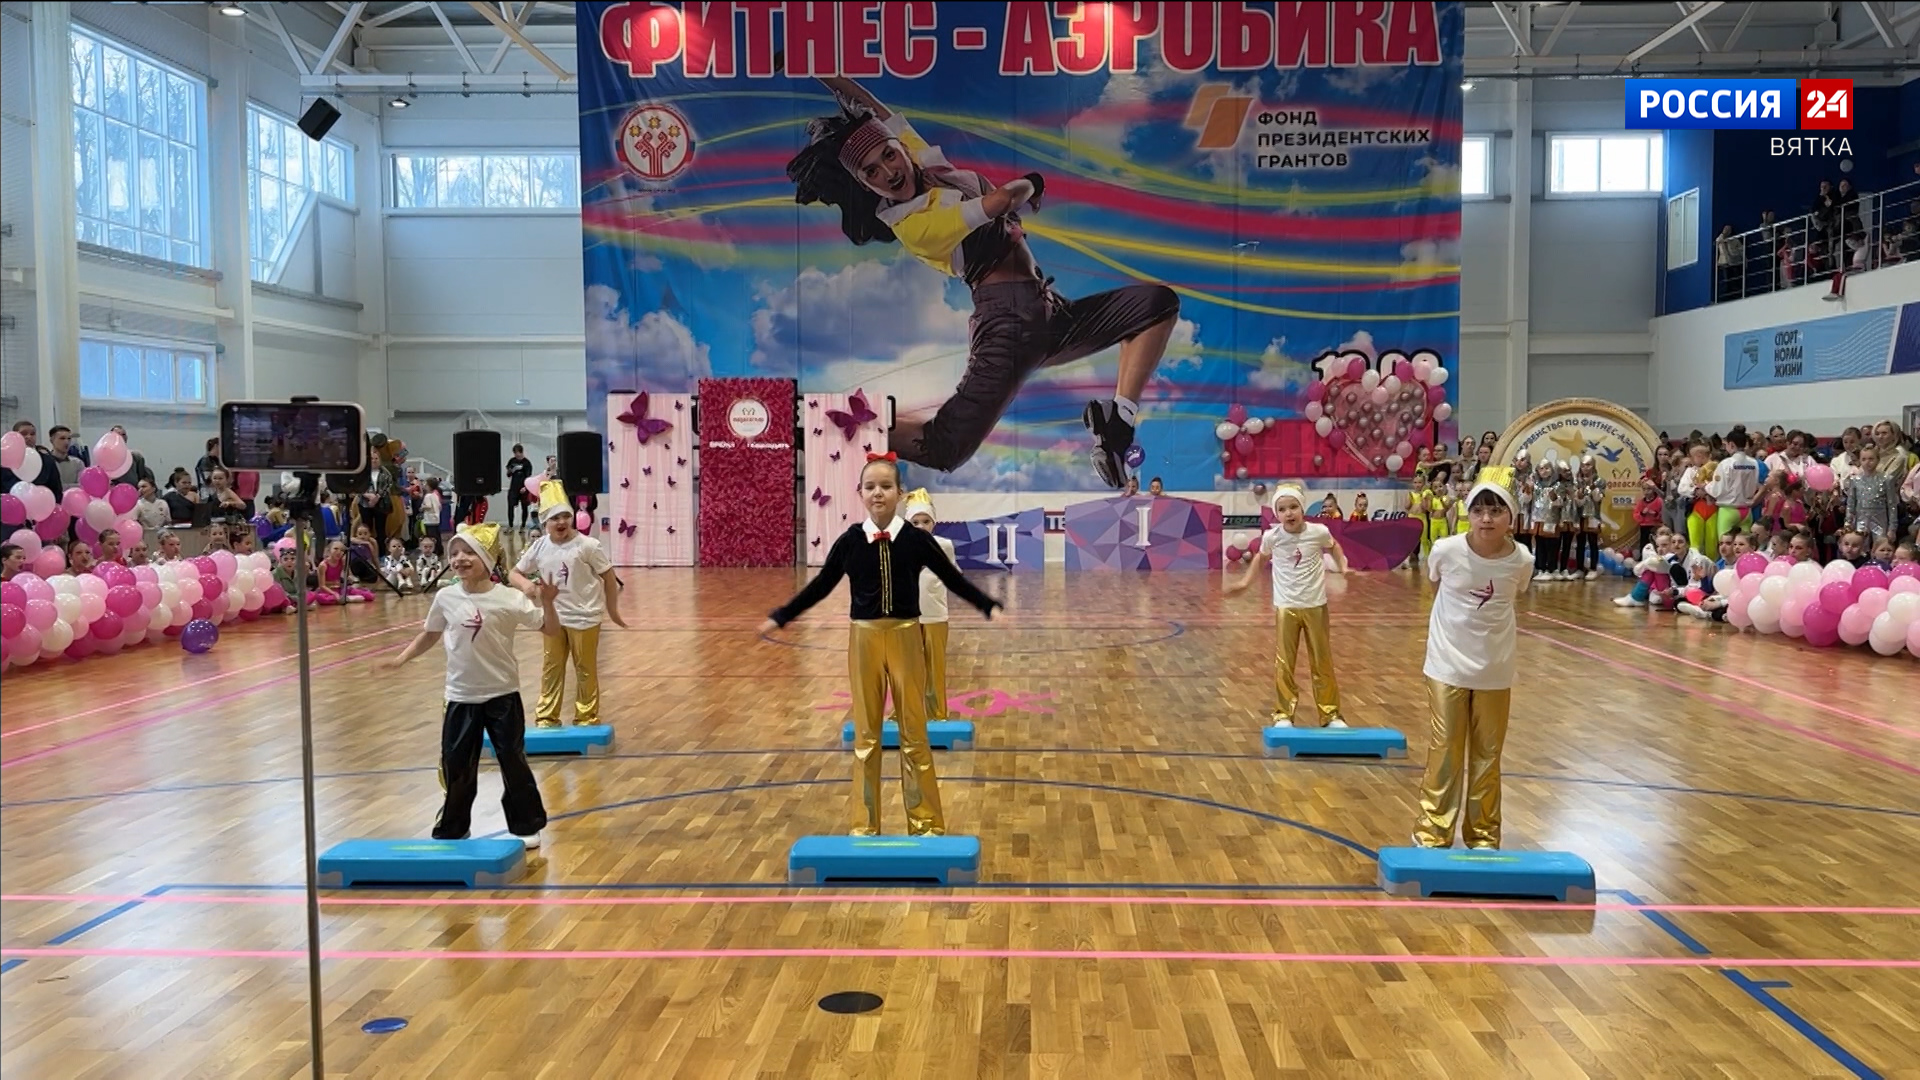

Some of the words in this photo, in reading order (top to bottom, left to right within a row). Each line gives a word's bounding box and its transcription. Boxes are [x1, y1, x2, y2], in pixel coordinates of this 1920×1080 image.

[600, 1, 938, 79] ФИТНЕС
[999, 1, 1443, 75] АЭРОБИКА
[1258, 111, 1317, 126] ФОНД
[1258, 129, 1430, 148] ПРЕЗИДЕНТСКИХ
[1257, 152, 1348, 169] ГРАНТОВ
[1774, 329, 1799, 346] СПОРТ
[1774, 345, 1803, 362] НОРМА
[1774, 361, 1803, 378] ЖИЗНИ
[1565, 418, 1579, 427] ПО
